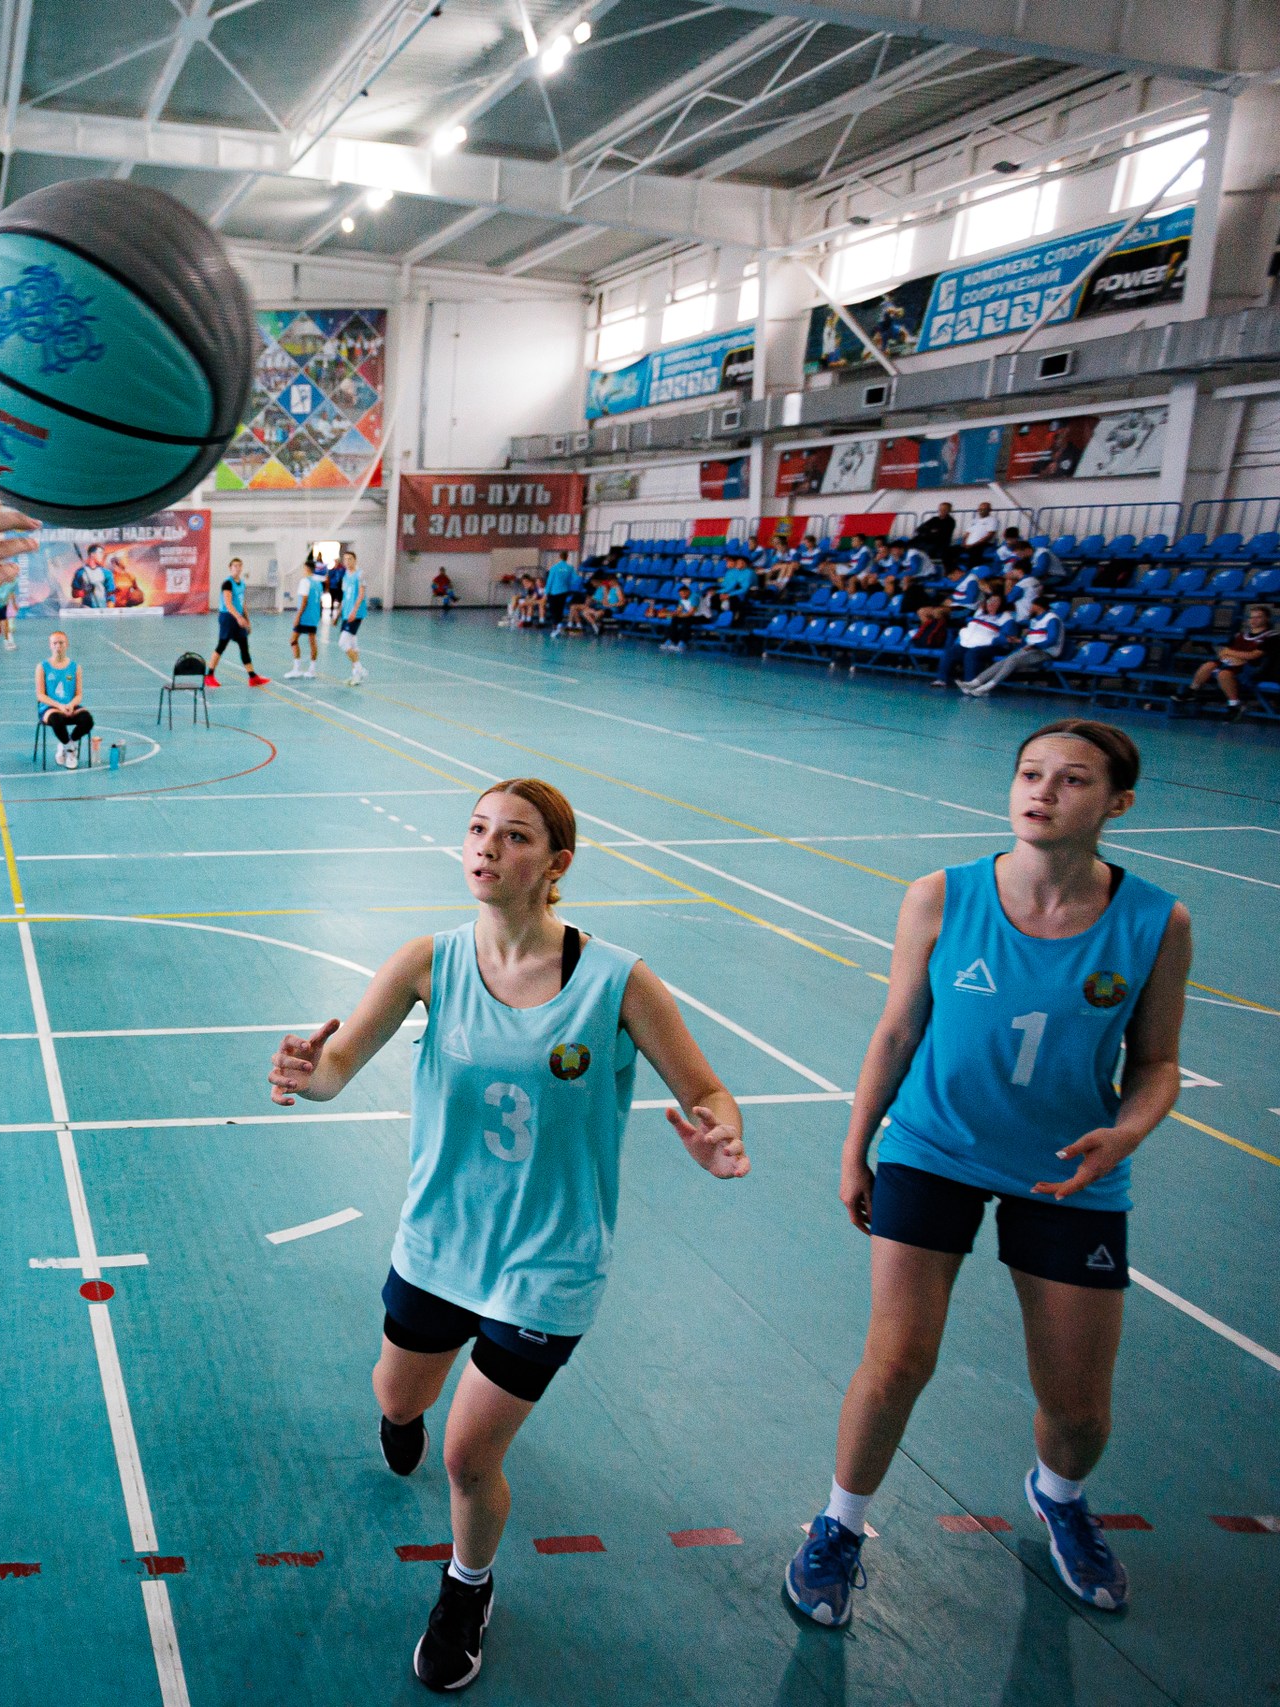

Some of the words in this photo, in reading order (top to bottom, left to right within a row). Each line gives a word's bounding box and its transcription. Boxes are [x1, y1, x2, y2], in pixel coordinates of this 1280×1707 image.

[402, 513, 416, 535] К
[428, 513, 581, 538] ЗДОРОВЬЮ!
[1011, 1011, 1049, 1087] 1
[483, 1082, 533, 1163] 3
